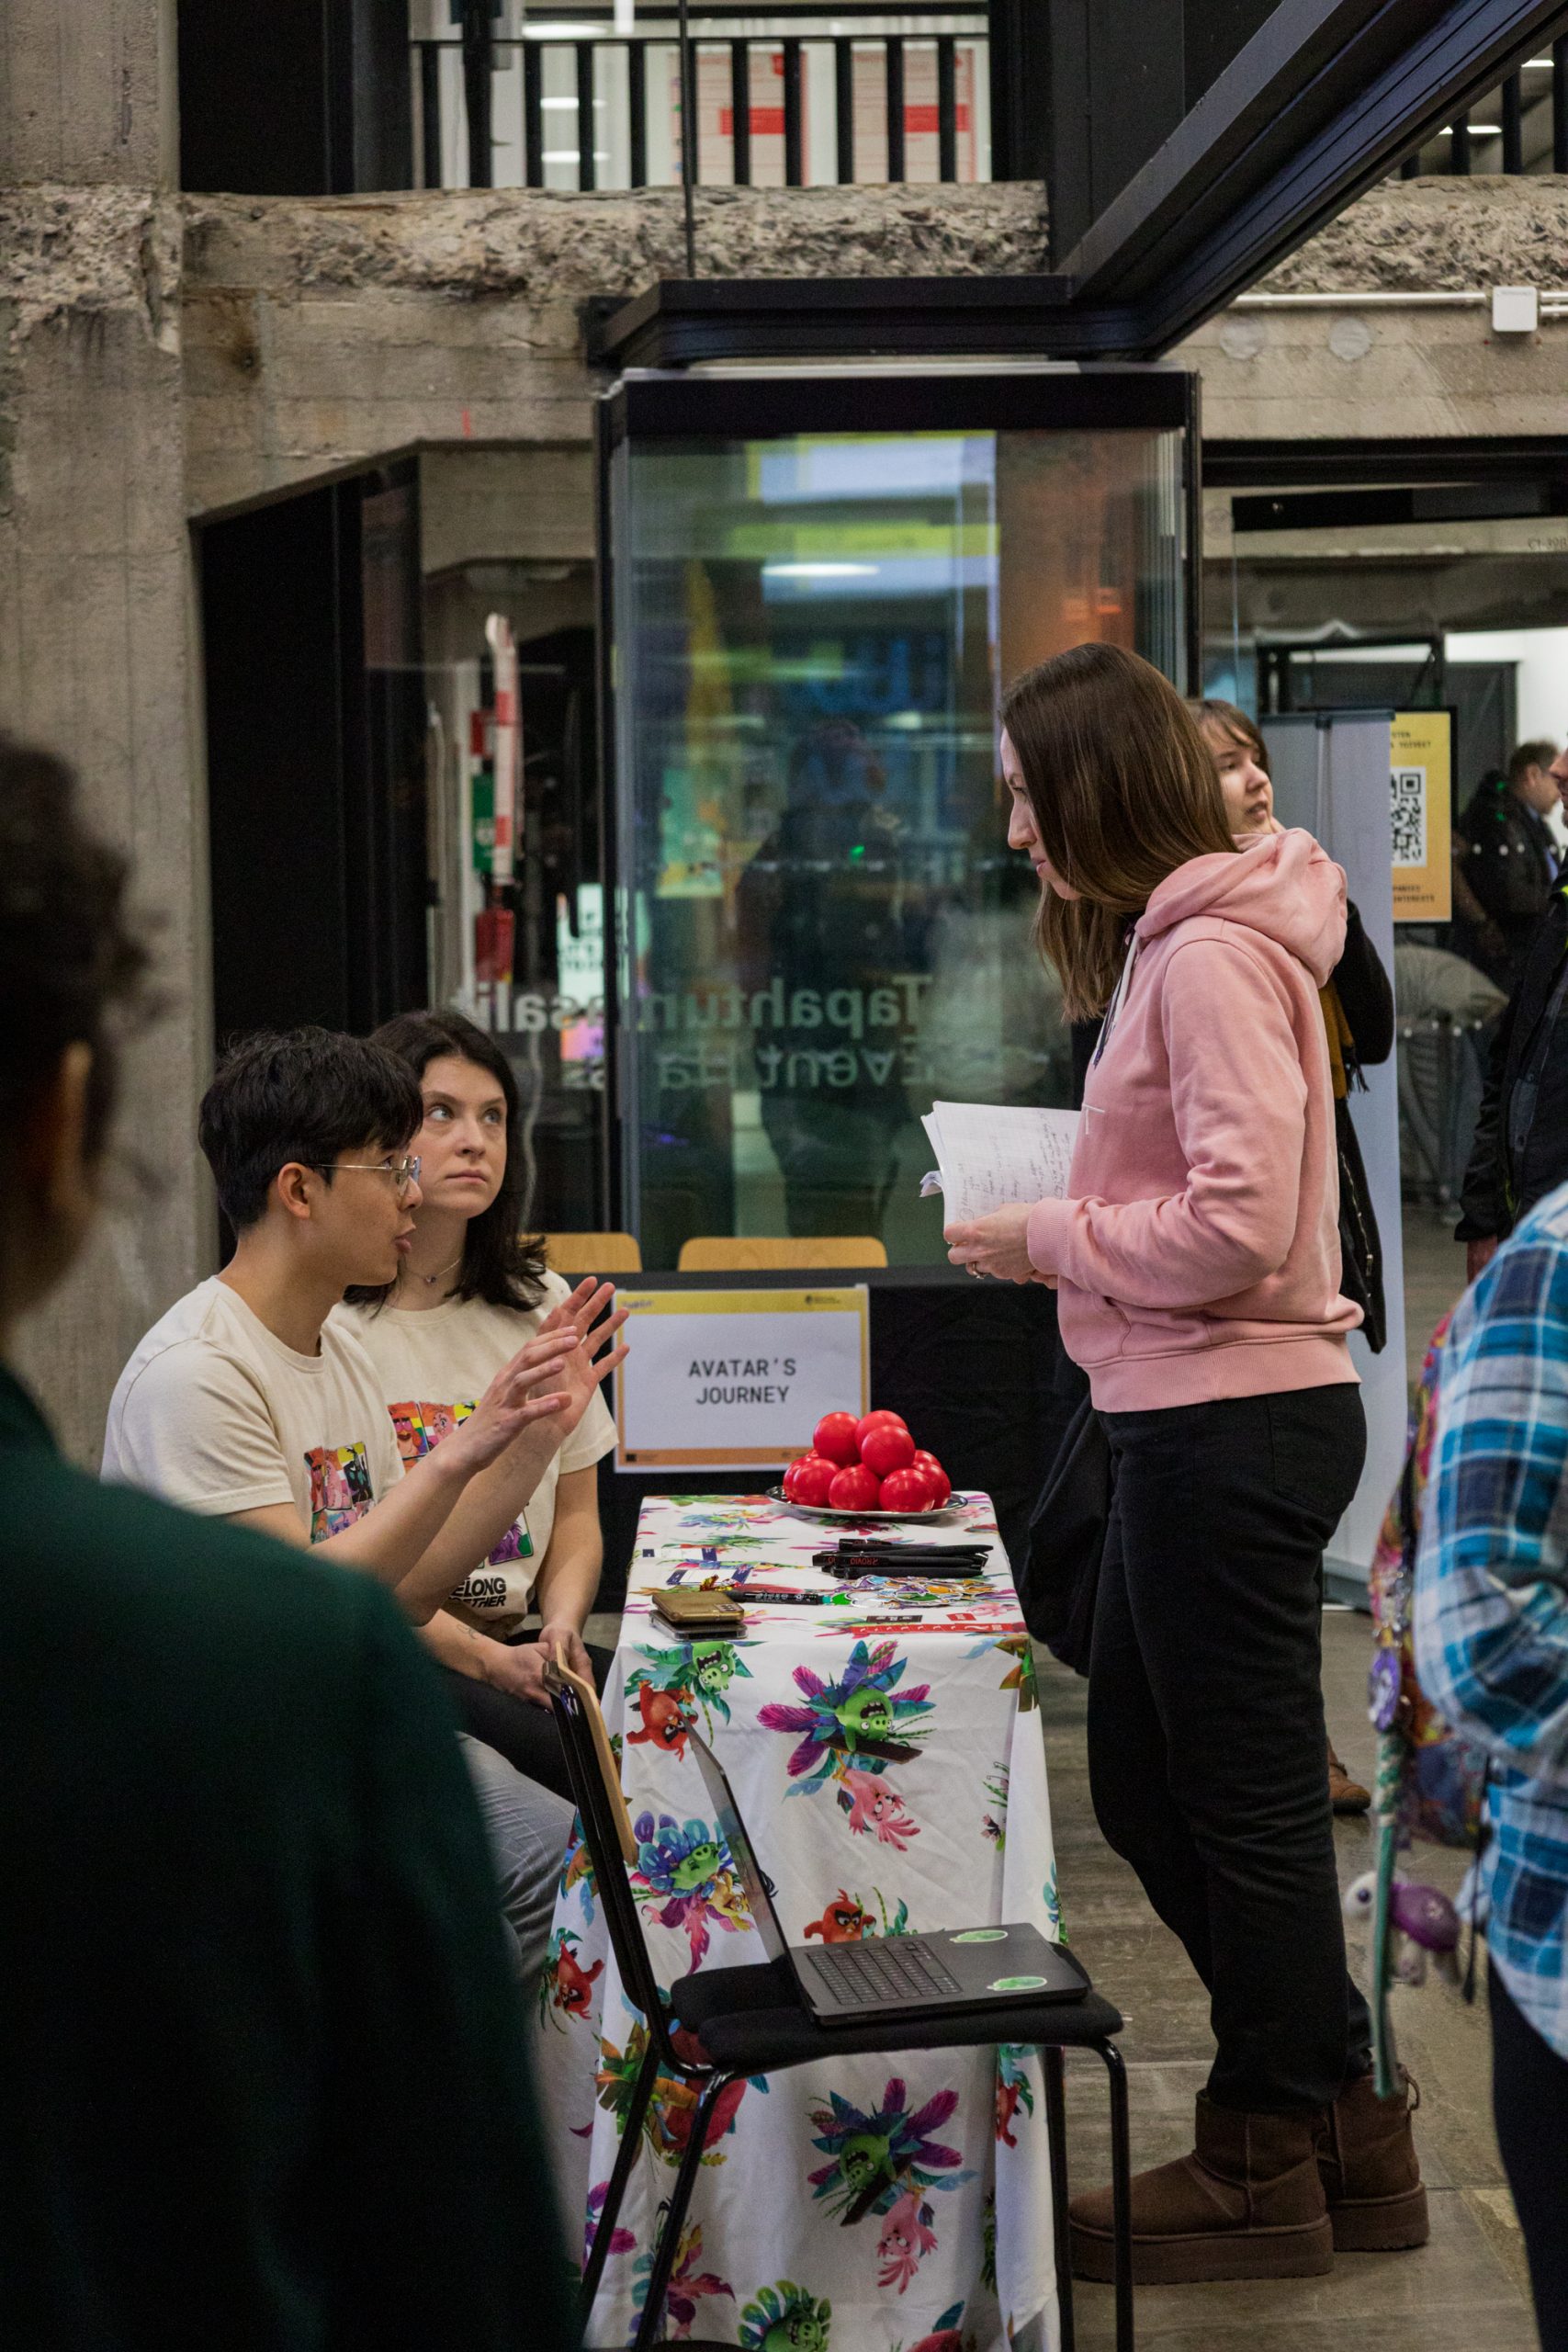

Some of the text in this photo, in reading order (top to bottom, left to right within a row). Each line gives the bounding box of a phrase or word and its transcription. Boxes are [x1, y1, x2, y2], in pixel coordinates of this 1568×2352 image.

[689, 1357, 797, 1378] AVATAR'S
[695, 1385, 790, 1405] JOURNEY
[449, 1577, 507, 1597] ELONG
